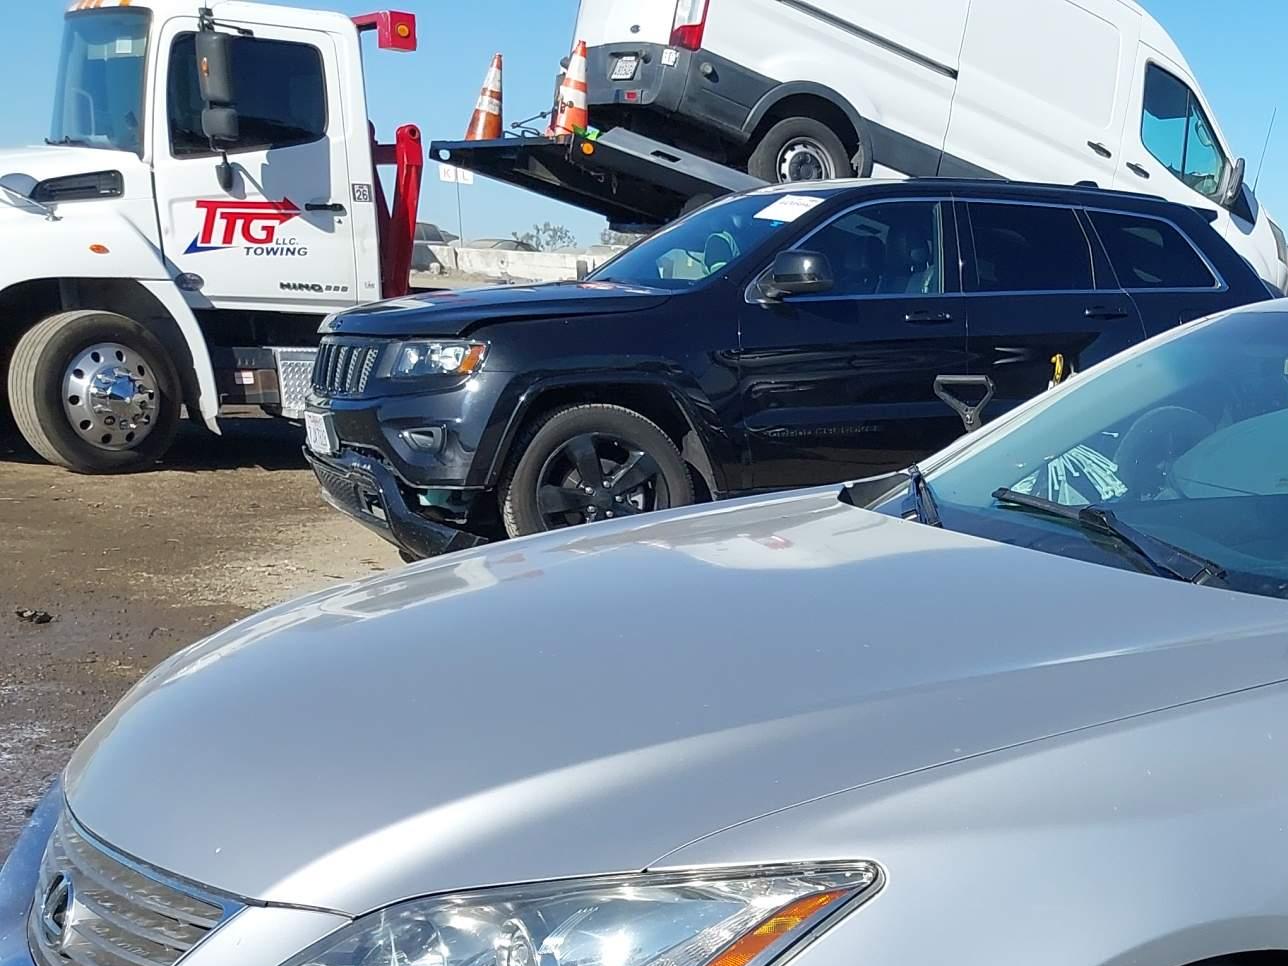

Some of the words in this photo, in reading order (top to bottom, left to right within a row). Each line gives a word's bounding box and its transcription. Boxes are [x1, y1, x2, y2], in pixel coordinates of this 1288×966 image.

[356, 189, 368, 200] 26
[196, 199, 282, 245] TTG
[244, 246, 308, 257] TOWING
